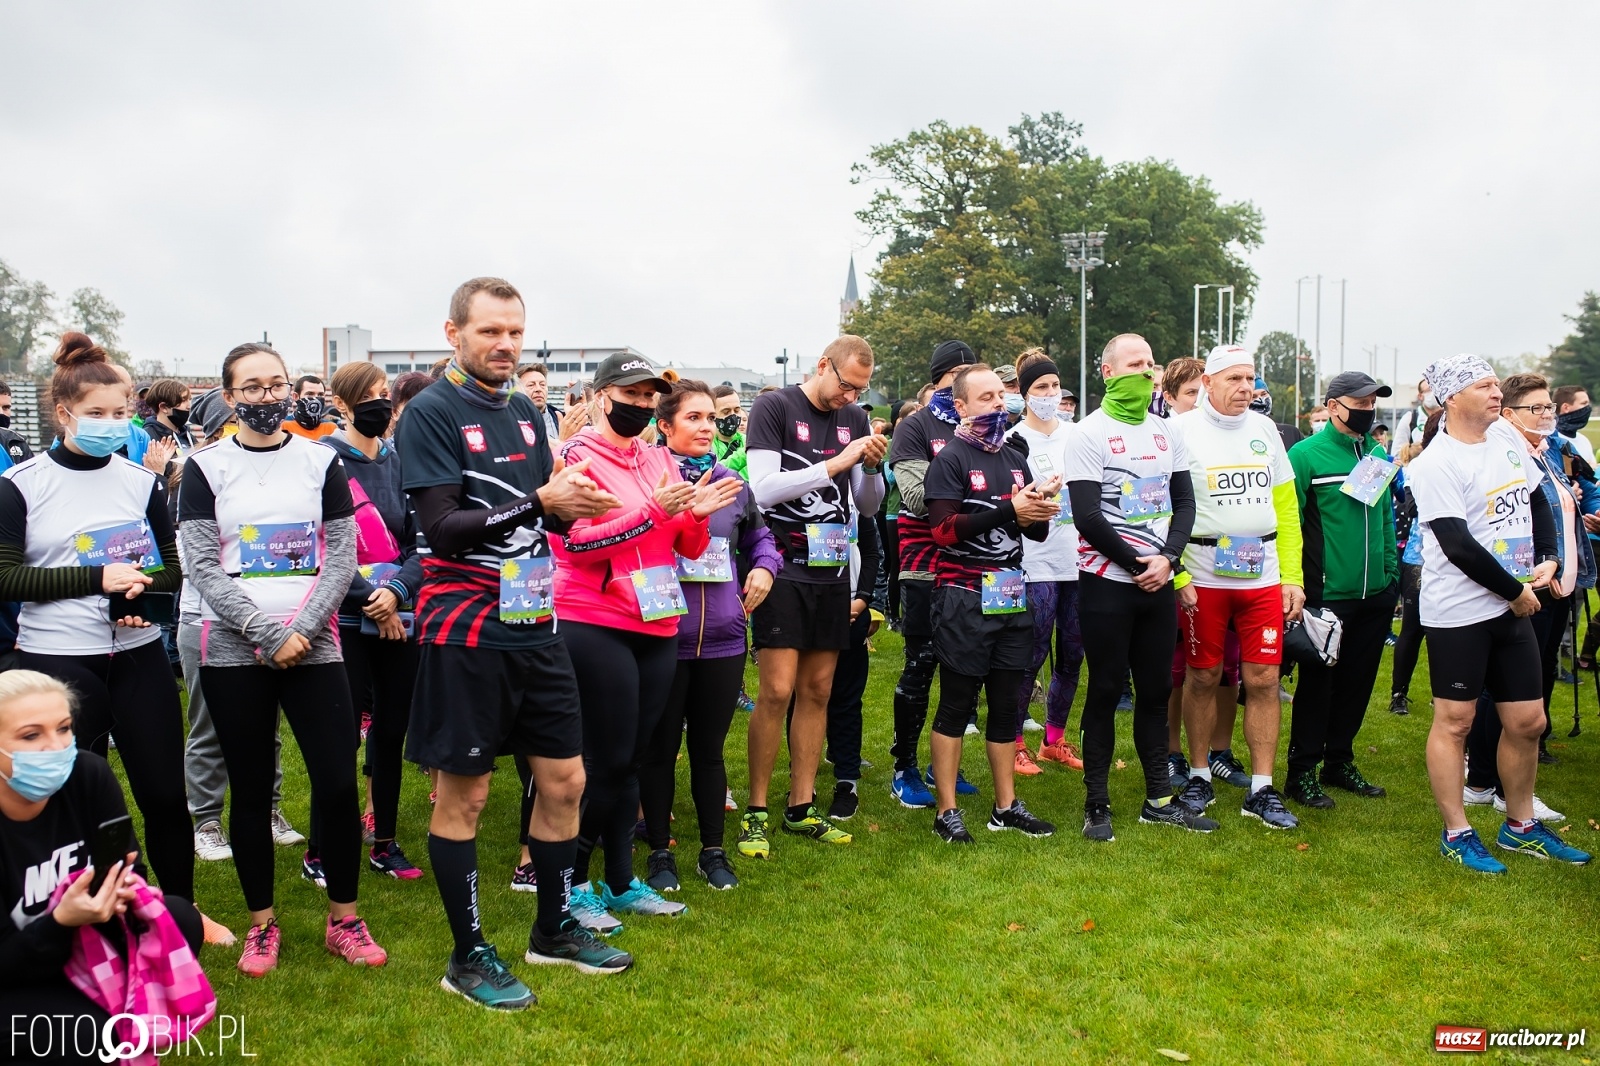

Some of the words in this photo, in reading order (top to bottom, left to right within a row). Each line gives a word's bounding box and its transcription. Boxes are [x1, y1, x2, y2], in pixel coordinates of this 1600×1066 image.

[87, 549, 105, 559] BIEG
[107, 546, 122, 554] DLA
[269, 542, 284, 550] DLA
[288, 555, 311, 570] 326
